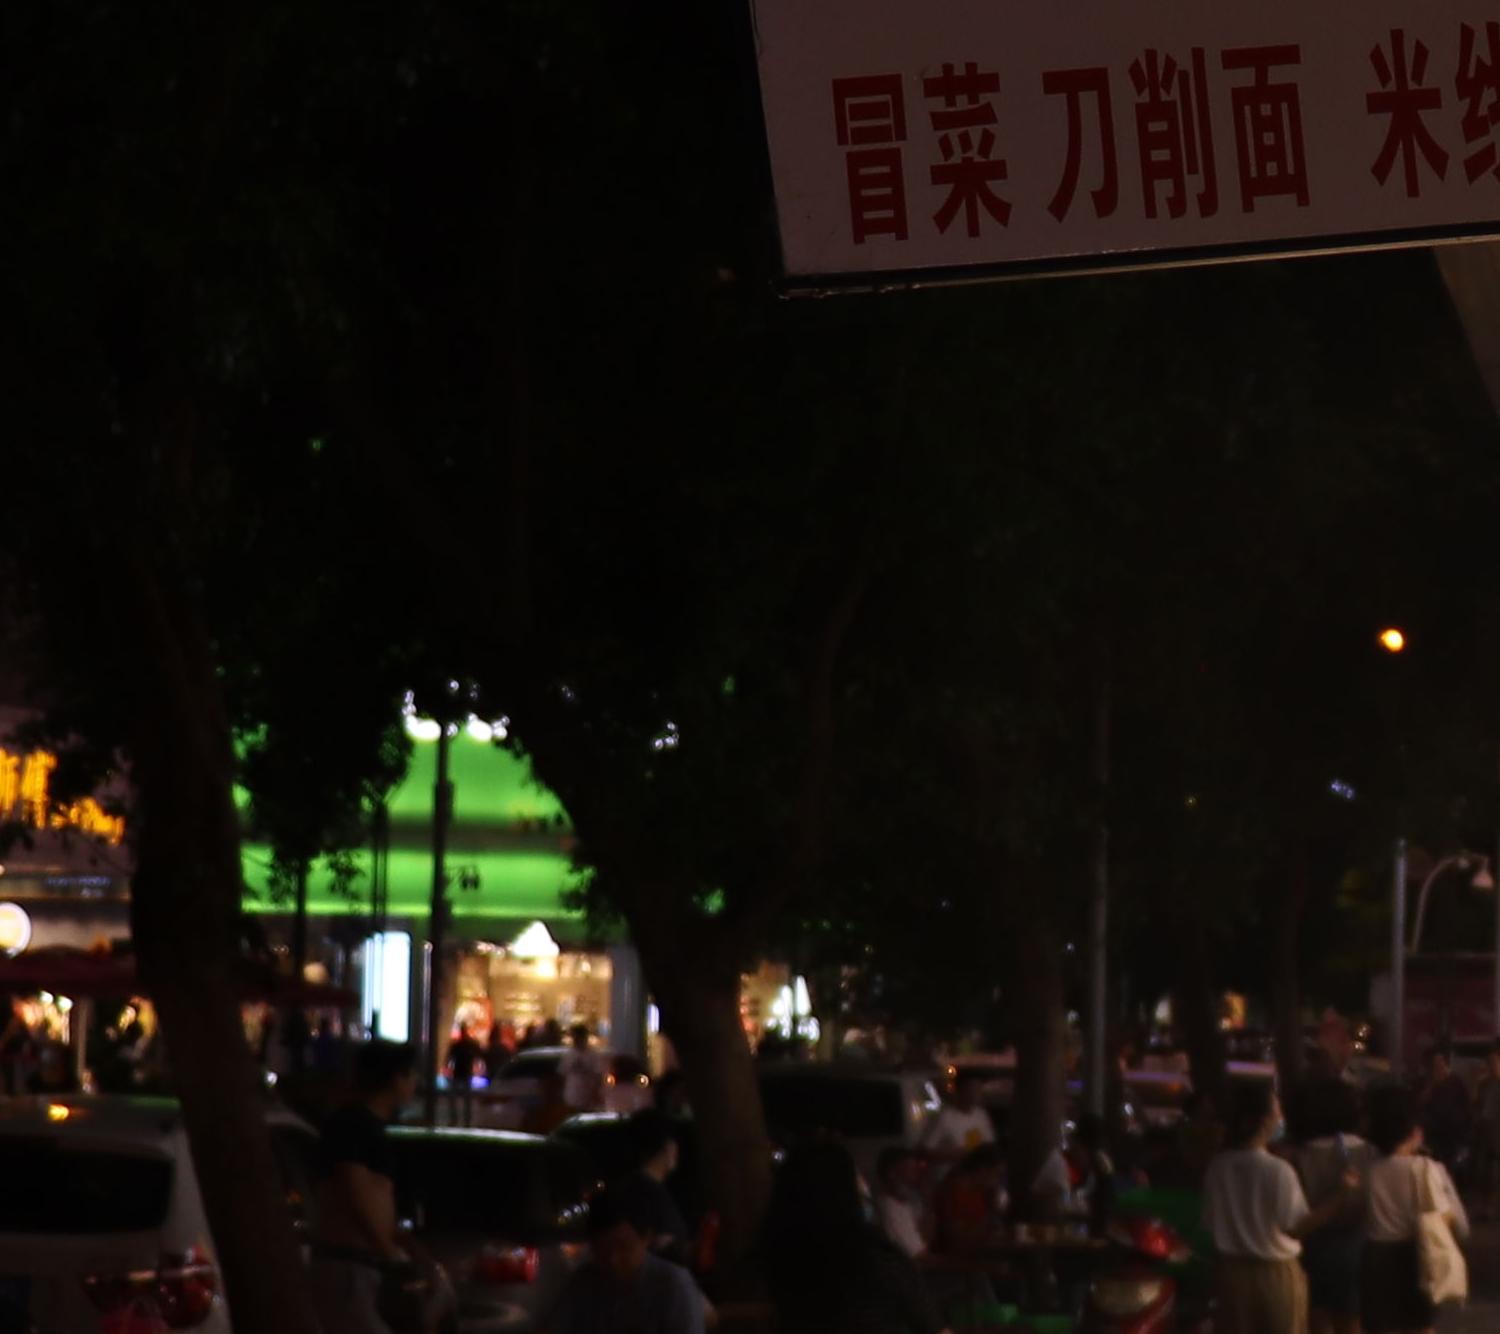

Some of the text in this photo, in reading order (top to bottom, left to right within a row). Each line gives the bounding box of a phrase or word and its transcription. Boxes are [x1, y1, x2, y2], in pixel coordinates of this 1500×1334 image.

[833, 61, 1012, 244] 冒菜
[1043, 44, 1309, 224] 刀削面
